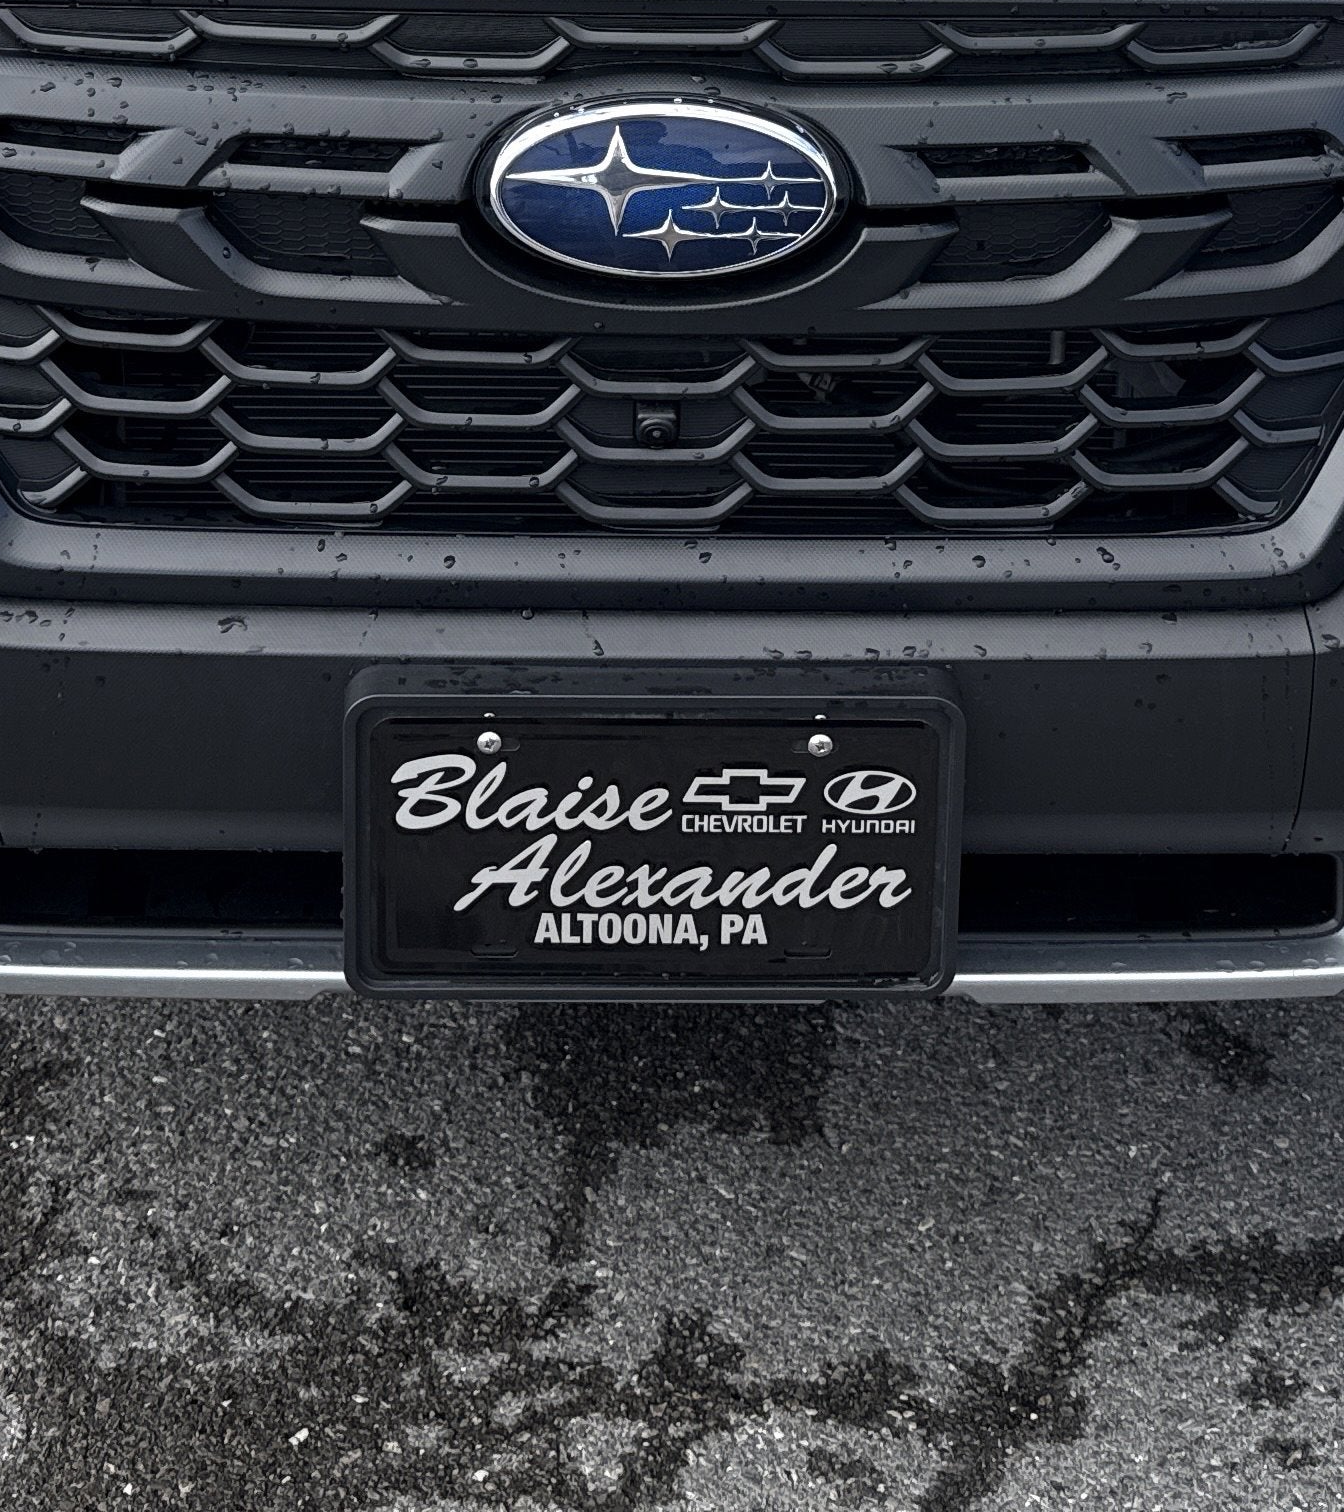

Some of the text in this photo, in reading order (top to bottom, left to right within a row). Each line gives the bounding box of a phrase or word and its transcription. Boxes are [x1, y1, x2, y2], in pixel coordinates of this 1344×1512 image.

[390, 753, 673, 831] Blaise
[681, 814, 808, 834] CHEVROLET
[821, 819, 916, 834] HYUNDAI
[453, 833, 912, 911] Alexander
[533, 912, 768, 952] ALTOONA, PA
